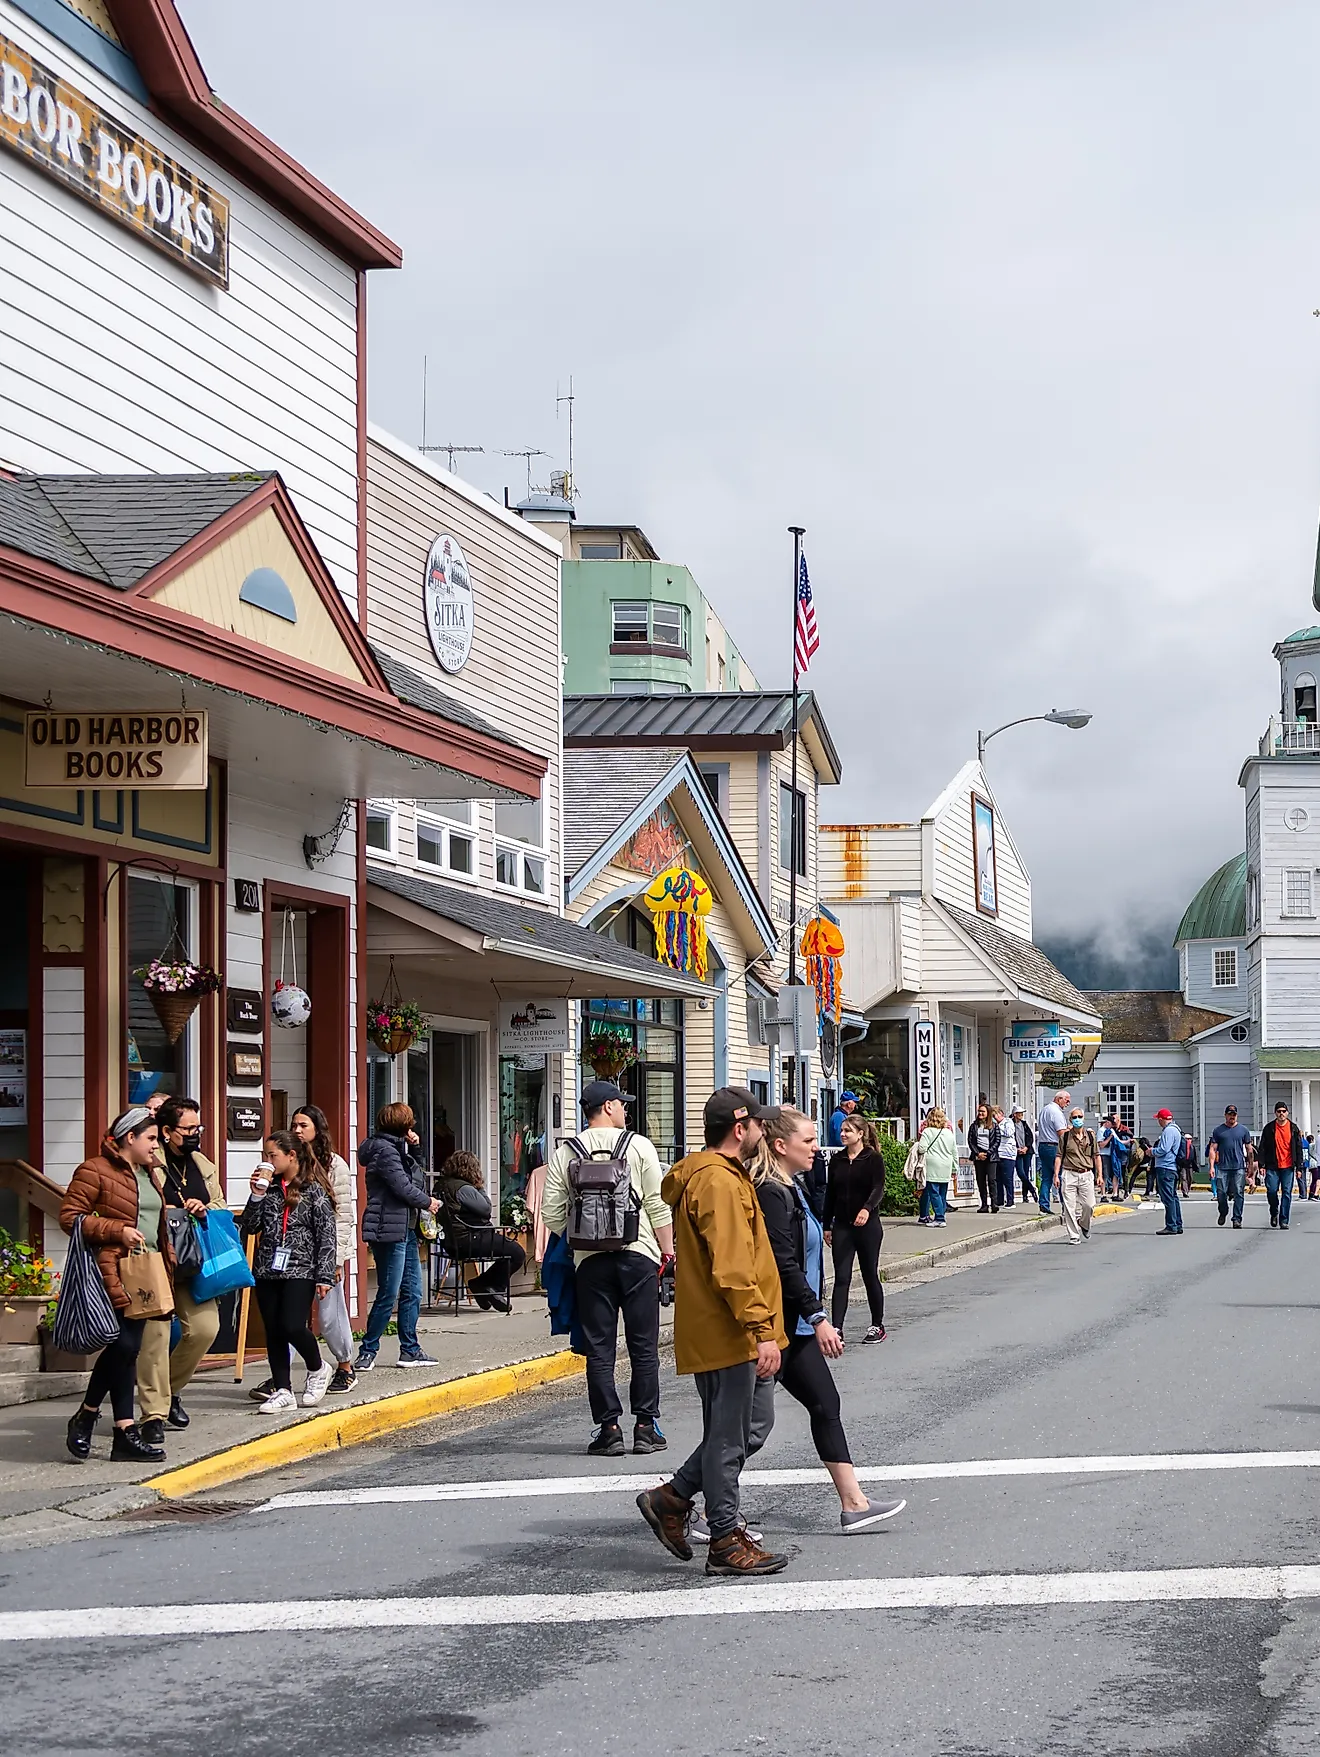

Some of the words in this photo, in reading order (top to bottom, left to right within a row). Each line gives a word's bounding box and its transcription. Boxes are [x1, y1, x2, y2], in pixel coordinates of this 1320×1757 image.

[1, 61, 85, 167] BOR
[98, 128, 215, 254] BOOKS
[434, 596, 466, 627] SITKA
[438, 631, 465, 652] LIGHTHOUSE
[32, 717, 81, 745] OLD
[88, 717, 200, 745] HARBOR
[66, 751, 164, 778] BOOKS
[243, 884, 258, 908] 201
[1008, 1039, 1035, 1048] Blue
[1037, 1038, 1066, 1049] Eyed
[1019, 1049, 1055, 1059] BEAR
[917, 1029, 932, 1121] MUSEUM
[242, 1120, 256, 1129] Society
